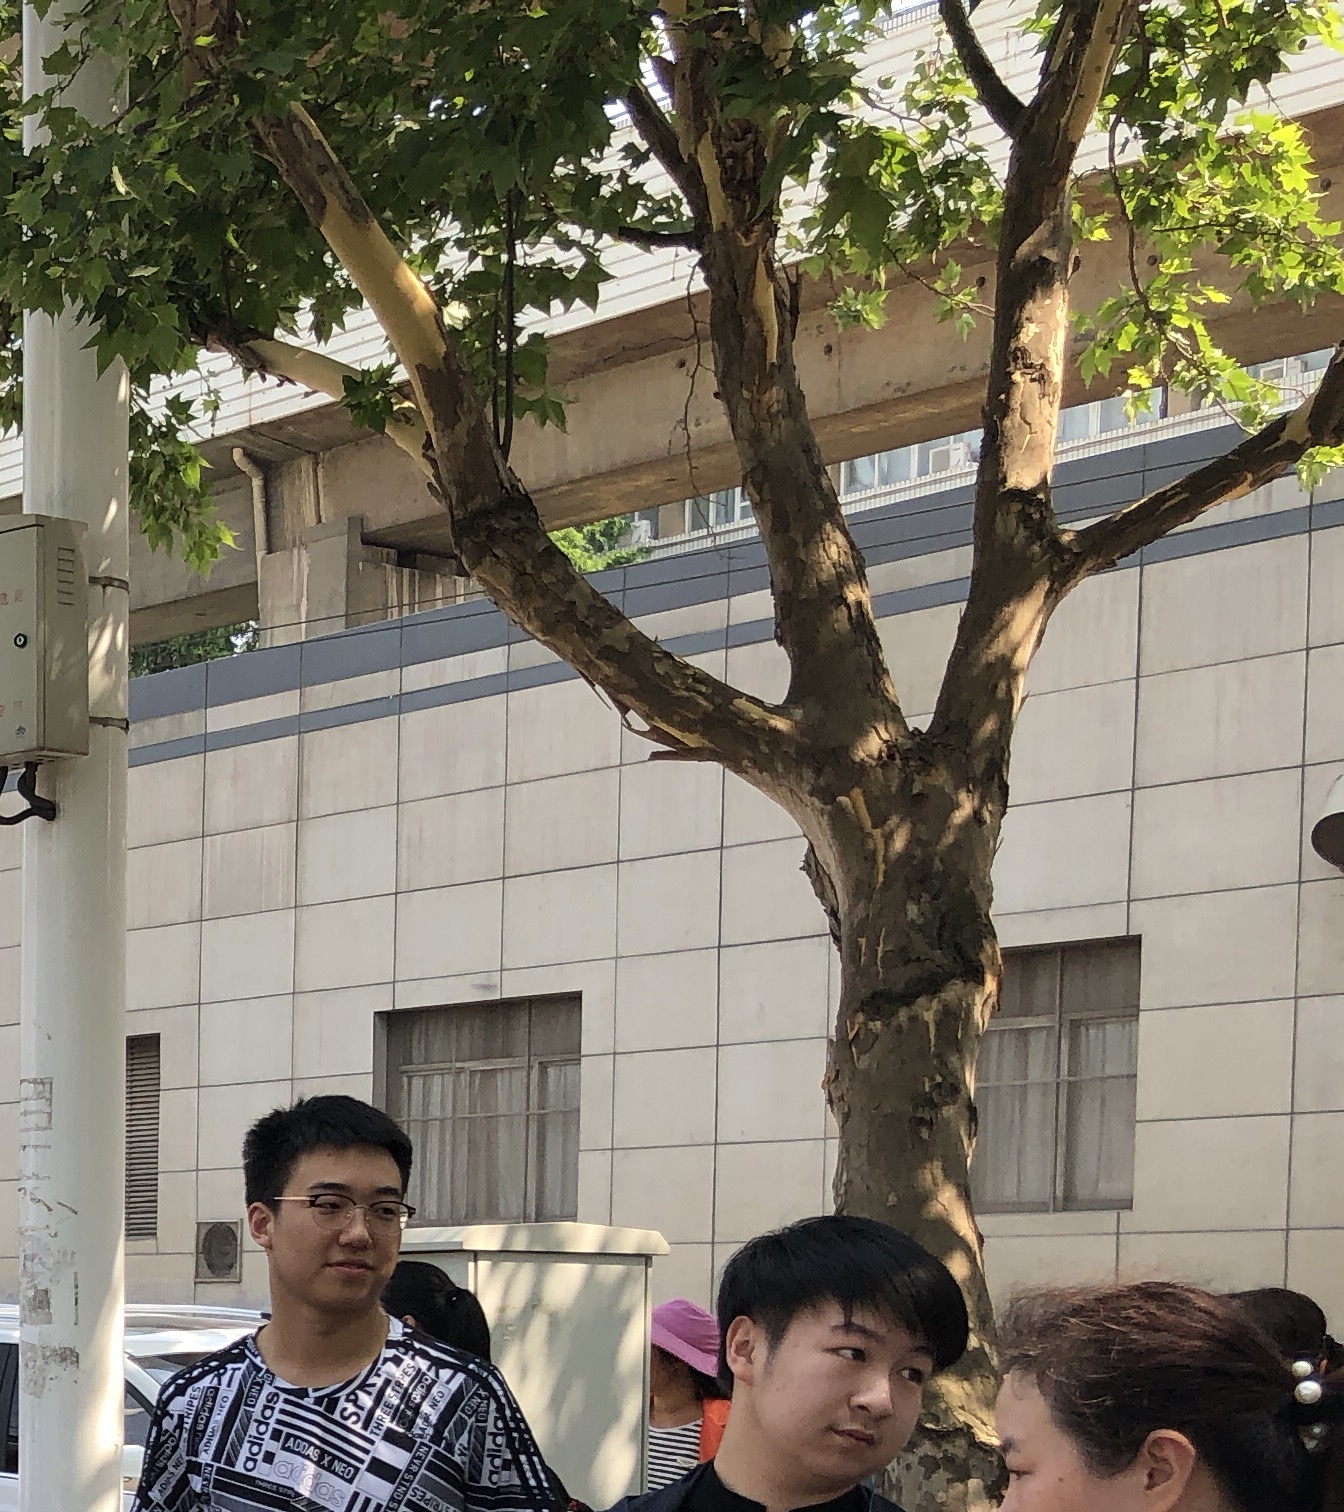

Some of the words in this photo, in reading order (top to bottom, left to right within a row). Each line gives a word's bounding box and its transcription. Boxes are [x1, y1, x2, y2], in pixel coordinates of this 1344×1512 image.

[243, 1391, 280, 1472] adidas
[369, 1399, 395, 1437] THREE
[320, 1454, 332, 1467] X
[330, 1460, 355, 1479] NEO
[411, 1445, 429, 1473] NEVR
[393, 1474, 414, 1501] STND
